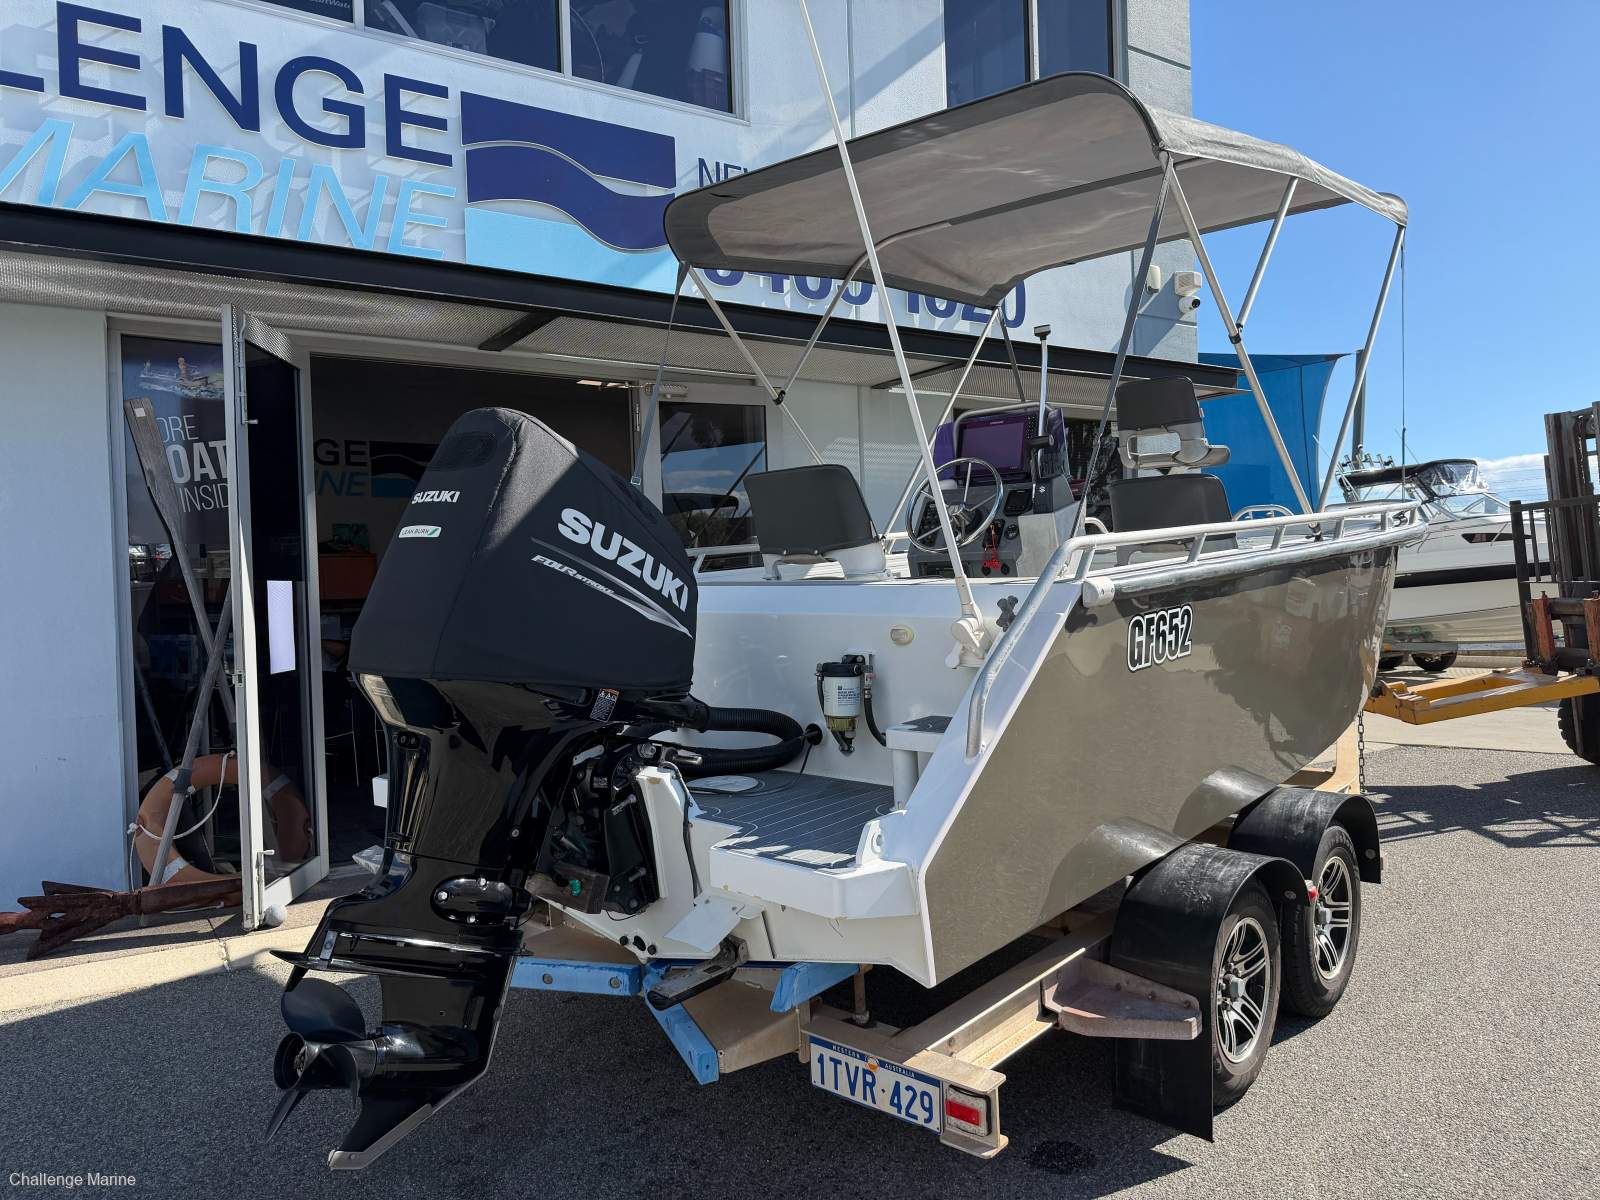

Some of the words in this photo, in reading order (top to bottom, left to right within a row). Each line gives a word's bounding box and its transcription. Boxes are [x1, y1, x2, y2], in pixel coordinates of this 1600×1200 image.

[165, 440, 228, 484] OAT
[179, 483, 229, 513] INSID
[411, 490, 461, 505] SUZUKI
[558, 508, 689, 612] SUZUKI
[1127, 604, 1193, 673] GF652
[832, 1044, 861, 1059] WESTERN
[884, 1063, 915, 1078] AUSTRALIA
